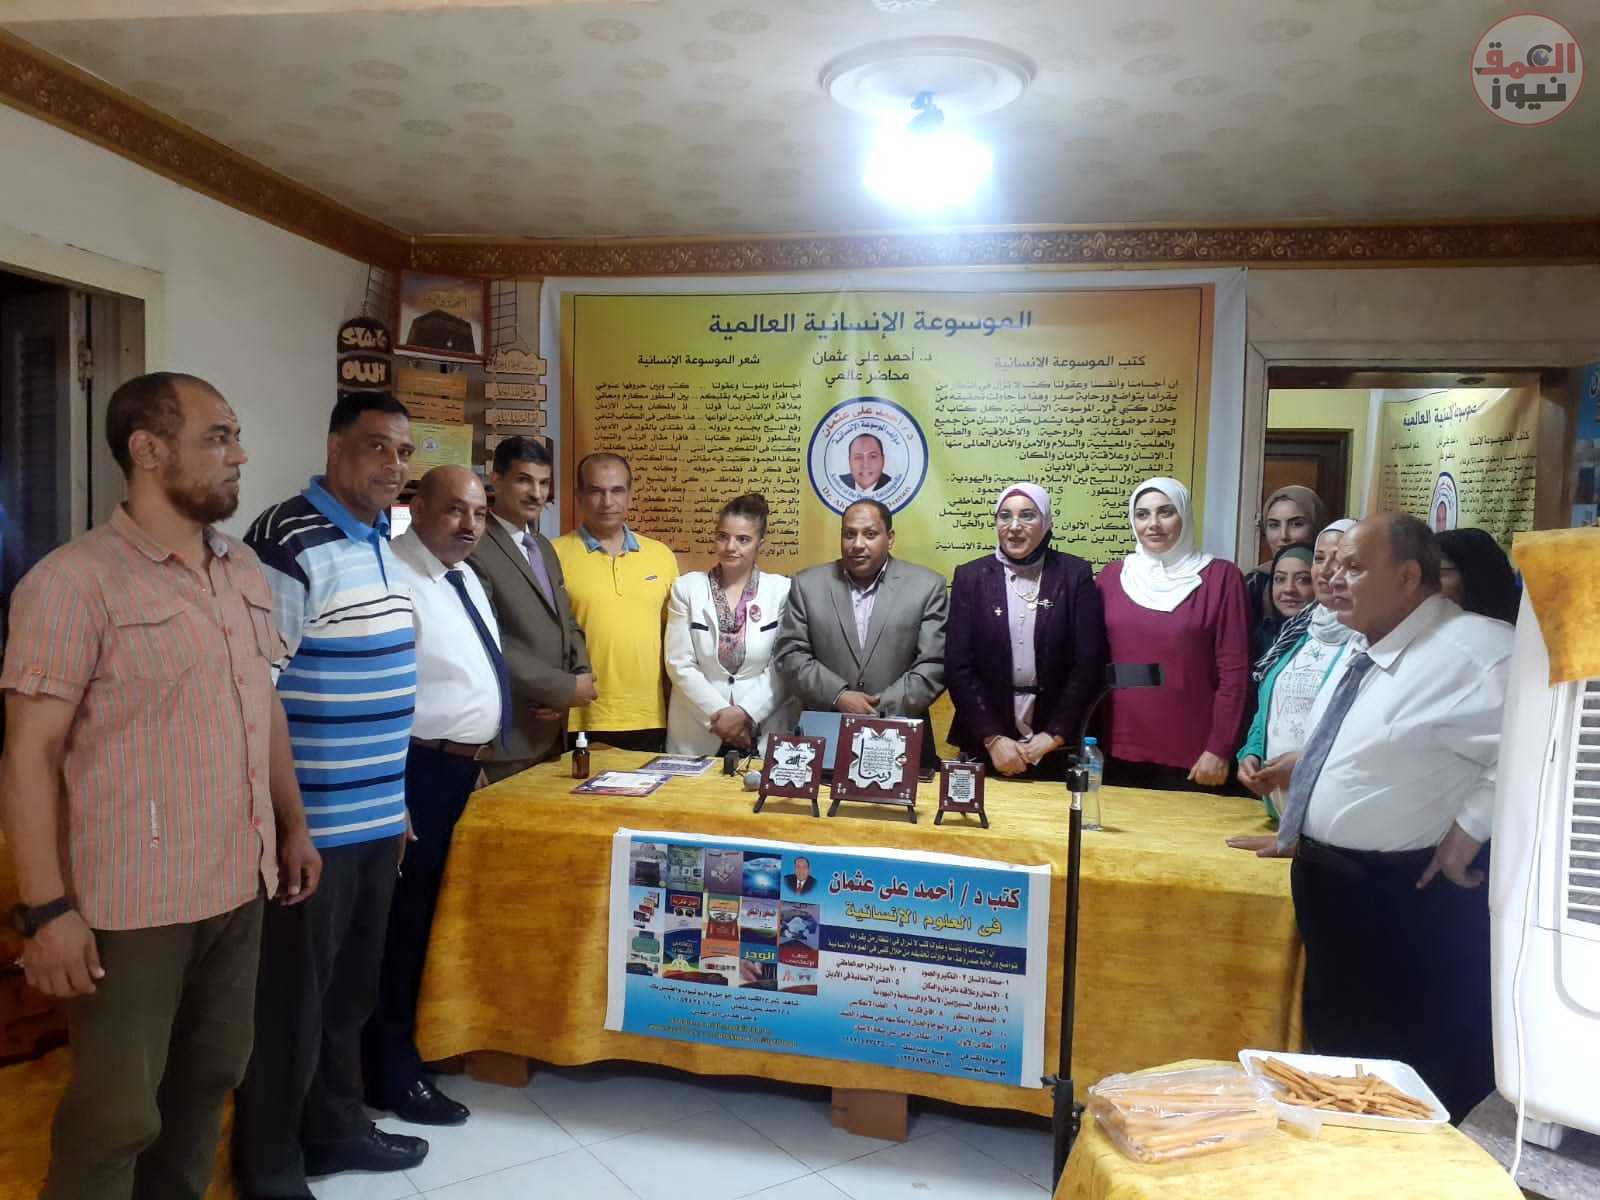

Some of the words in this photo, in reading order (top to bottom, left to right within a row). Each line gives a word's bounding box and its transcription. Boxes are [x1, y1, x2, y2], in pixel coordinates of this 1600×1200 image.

[708, 312, 795, 341] العالمية
[804, 310, 904, 341] الإنسانية
[913, 310, 1033, 337] الموسوعة
[685, 354, 735, 368] الموسوعة
[812, 350, 848, 366] عثمان
[883, 346, 915, 362] أحمد
[1052, 355, 1114, 370] الموسوعة
[1118, 355, 1145, 369] كتب
[866, 369, 909, 384] محاضر
[829, 869, 875, 895] عثمان
[879, 876, 909, 900] على
[914, 878, 955, 902] أحمد
[987, 887, 1021, 911] كتب
[846, 902, 919, 928] الإنسانية
[923, 912, 972, 931] العلوم
